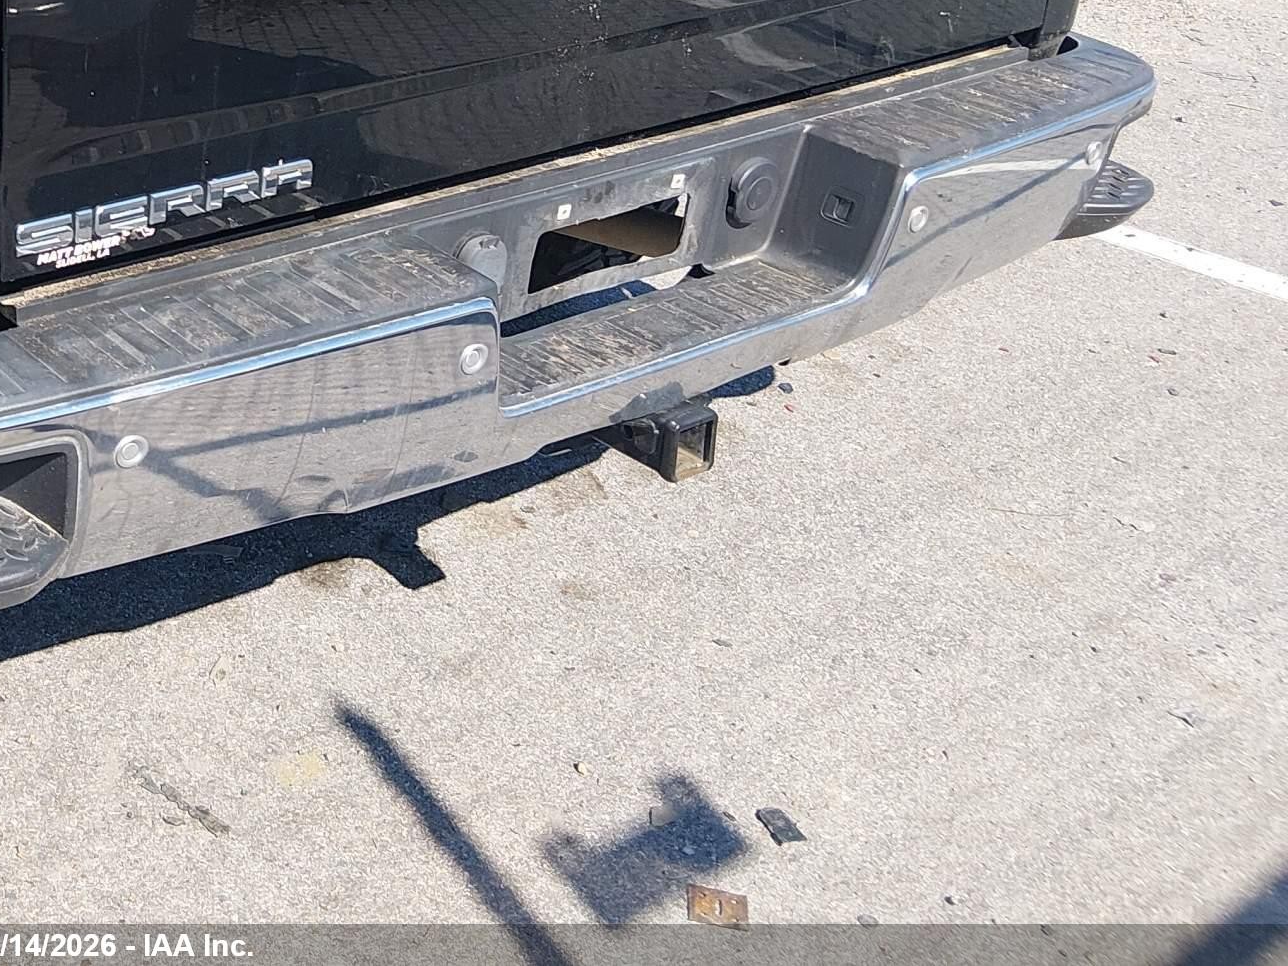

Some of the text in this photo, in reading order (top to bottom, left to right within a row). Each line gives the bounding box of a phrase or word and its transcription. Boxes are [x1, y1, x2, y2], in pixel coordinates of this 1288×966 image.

[15, 158, 313, 258] SIERRA
[36, 246, 74, 266] MATT
[97, 247, 110, 258] LA
